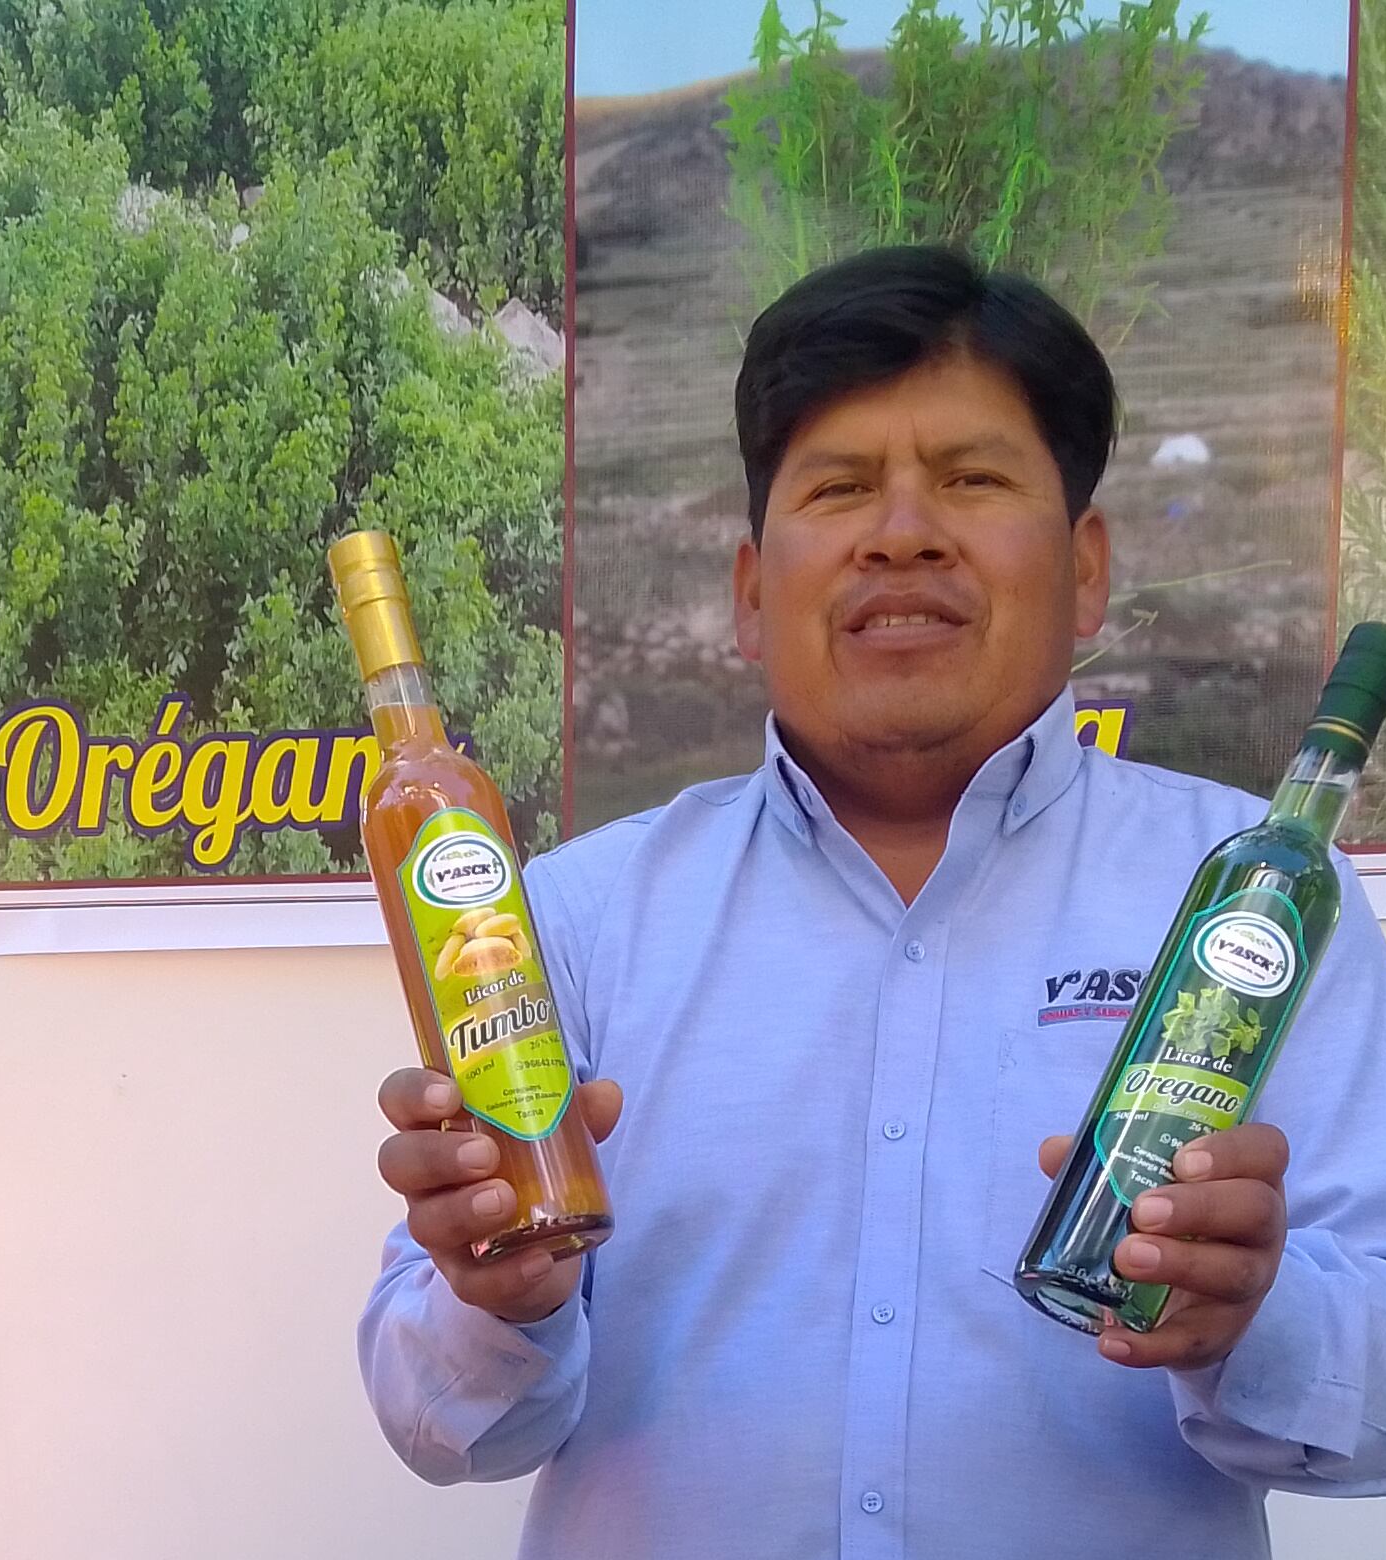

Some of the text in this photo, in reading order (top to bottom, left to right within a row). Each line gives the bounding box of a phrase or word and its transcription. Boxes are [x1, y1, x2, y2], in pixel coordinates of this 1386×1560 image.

[465, 969, 525, 1006] Licor de
[448, 994, 550, 1061] Tumbo
[1163, 1046, 1233, 1074] Licor de
[1124, 1068, 1240, 1113] Oregano
[1130, 1169, 1158, 1189] Tacna
